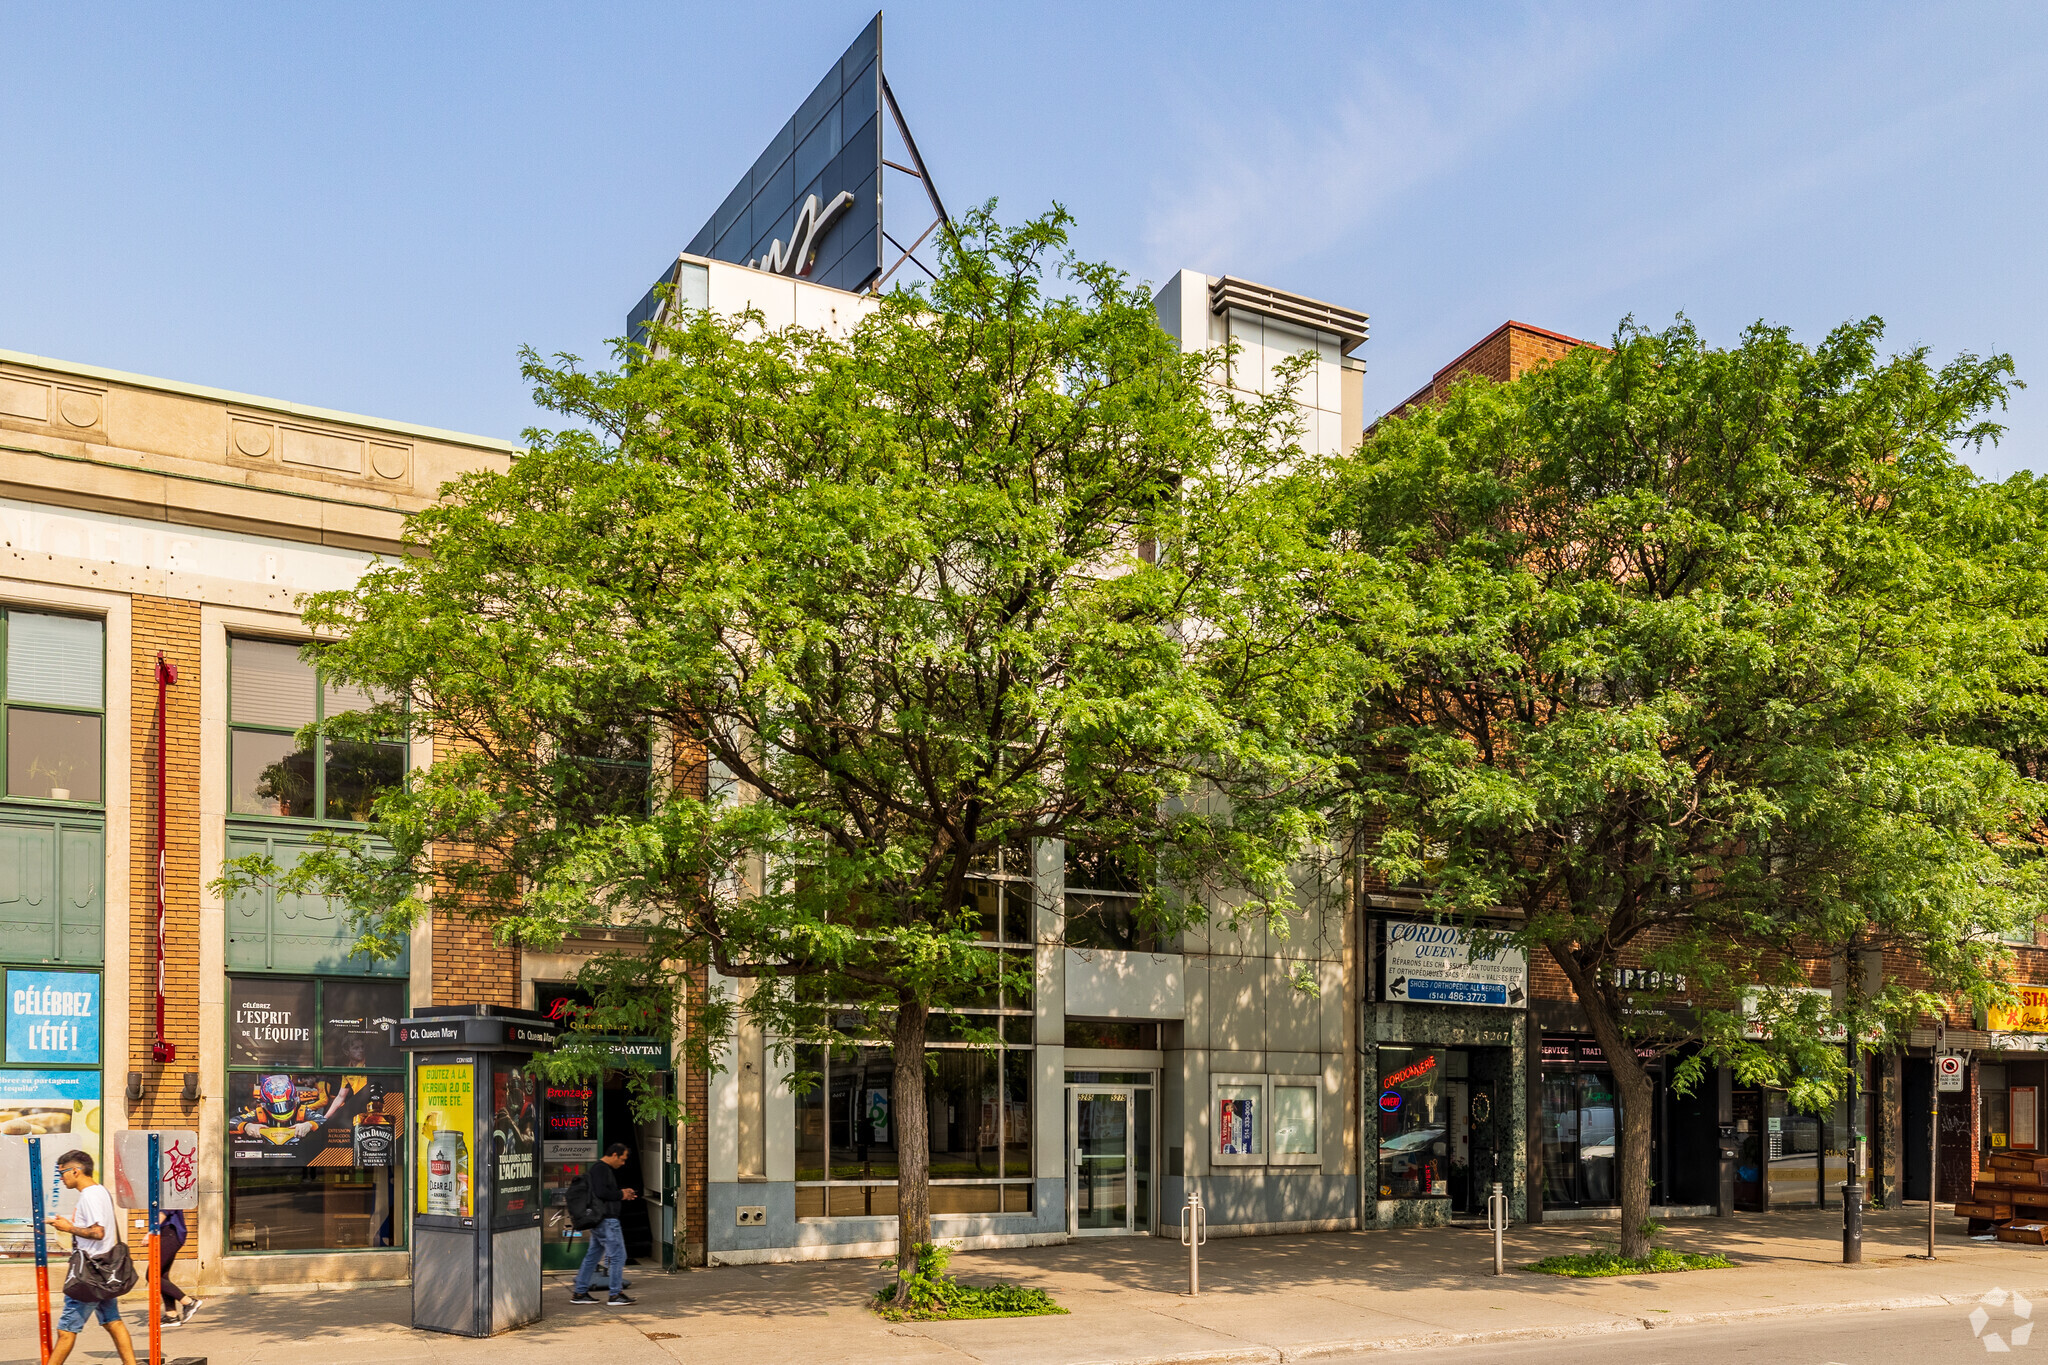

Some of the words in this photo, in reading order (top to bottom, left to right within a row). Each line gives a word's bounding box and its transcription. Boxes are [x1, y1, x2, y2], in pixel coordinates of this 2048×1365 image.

[1415, 944, 1457, 958] QUEEN
[1392, 957, 1421, 967] RÉPARONS
[1423, 960, 1433, 968] LES
[1480, 965, 1500, 973] TOUTES
[1502, 966, 1522, 974] SORTES
[1410, 980, 1429, 988] SHOES
[1434, 982, 1469, 991] ORTHOPEDIC
[1470, 984, 1480, 992] ALL
[1481, 985, 1505, 993] REPAIRS
[14, 985, 92, 1017] CÉLÉBREZ
[1448, 991, 1487, 1002] 486-3773
[236, 1010, 291, 1024] L'ESPRIT
[29, 1020, 69, 1050] L'ÉTÉ
[71, 1026, 78, 1050] !
[254, 1024, 310, 1043] L'ÉQUIPE
[410, 1030, 419, 1039] Ch.
[421, 1028, 440, 1039] Queen
[441, 1028, 458, 1039] Mary
[527, 1030, 543, 1041] Queen
[1482, 1031, 1509, 1041] 5267
[608, 1045, 662, 1055] SPRAYTAN
[1541, 1046, 1569, 1054] SERVICE
[458, 1069, 466, 1079] LA
[1384, 1055, 1437, 1089] CORDONNERIE
[34, 1078, 79, 1086] partageant
[422, 1082, 447, 1093] VERSION
[450, 1082, 460, 1093] 2.0
[462, 1082, 471, 1092] DE
[3, 1085, 38, 1093] tequila?
[547, 1088, 593, 1099] Bronzage
[428, 1095, 448, 1106] VOTRE
[1380, 1097, 1400, 1106] OUVERT
[551, 1117, 586, 1127] OUVERT
[357, 1130, 371, 1141] JACK
[551, 1145, 592, 1153] Bronzage
[431, 1163, 449, 1171] SLEEMAN
[499, 1162, 532, 1180] L'ACTION
[430, 1180, 443, 1190] CLEAR
